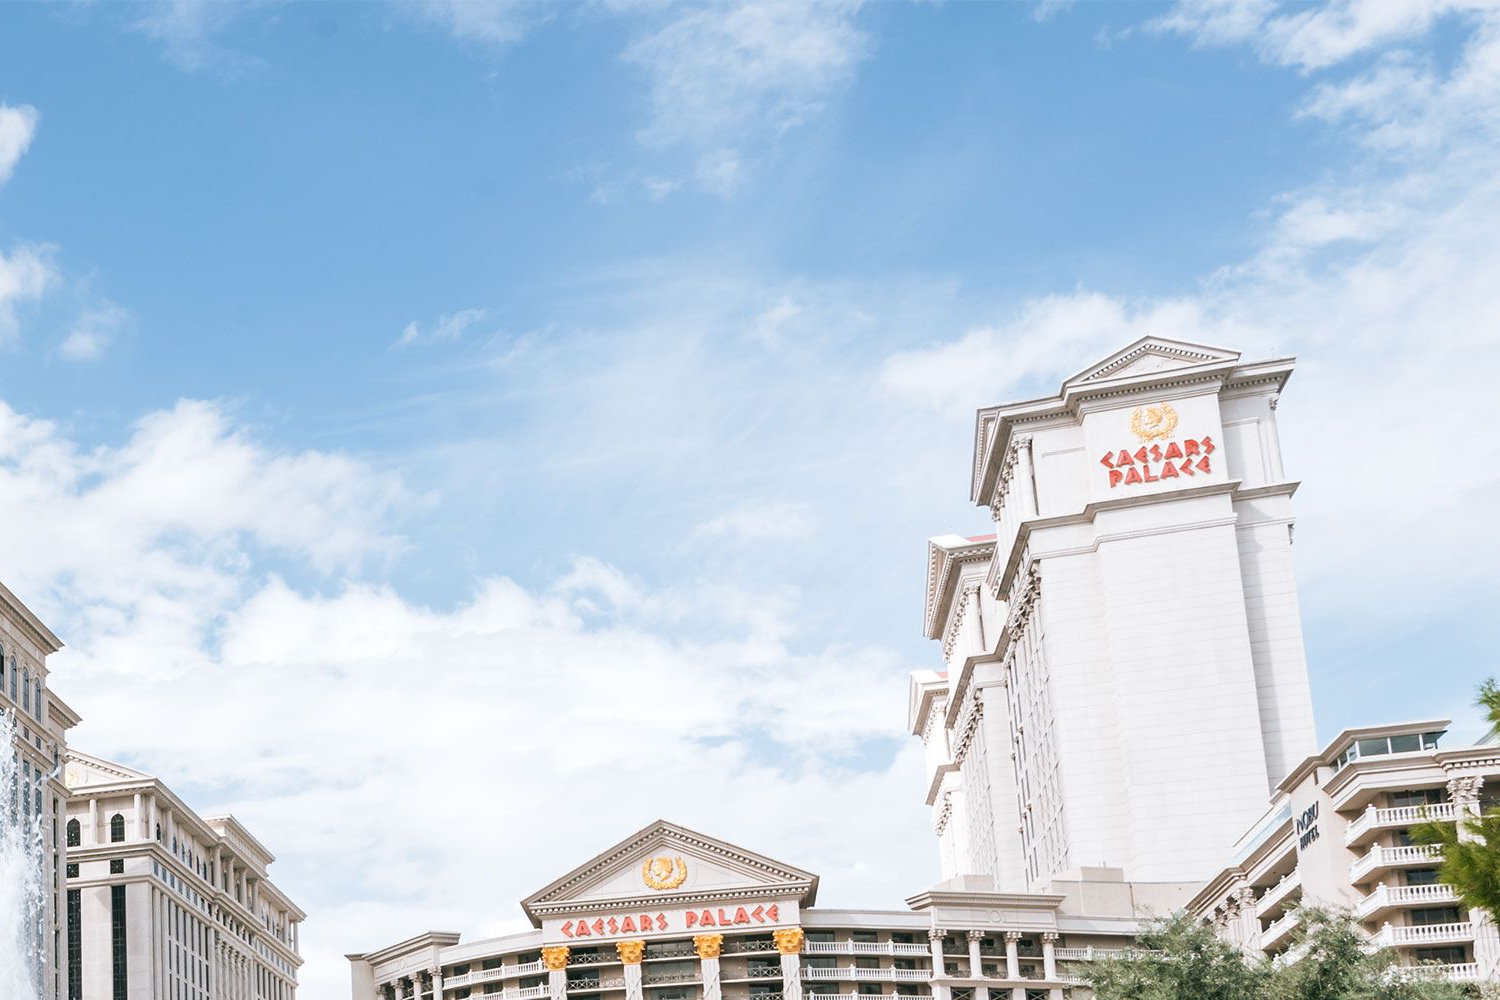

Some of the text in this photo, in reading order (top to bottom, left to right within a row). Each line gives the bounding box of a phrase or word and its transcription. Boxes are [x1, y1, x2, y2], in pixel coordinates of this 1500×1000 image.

[1100, 435, 1216, 469] CAESARS
[1109, 455, 1211, 489] PALACE
[560, 903, 780, 938] CAESARS PALACE
